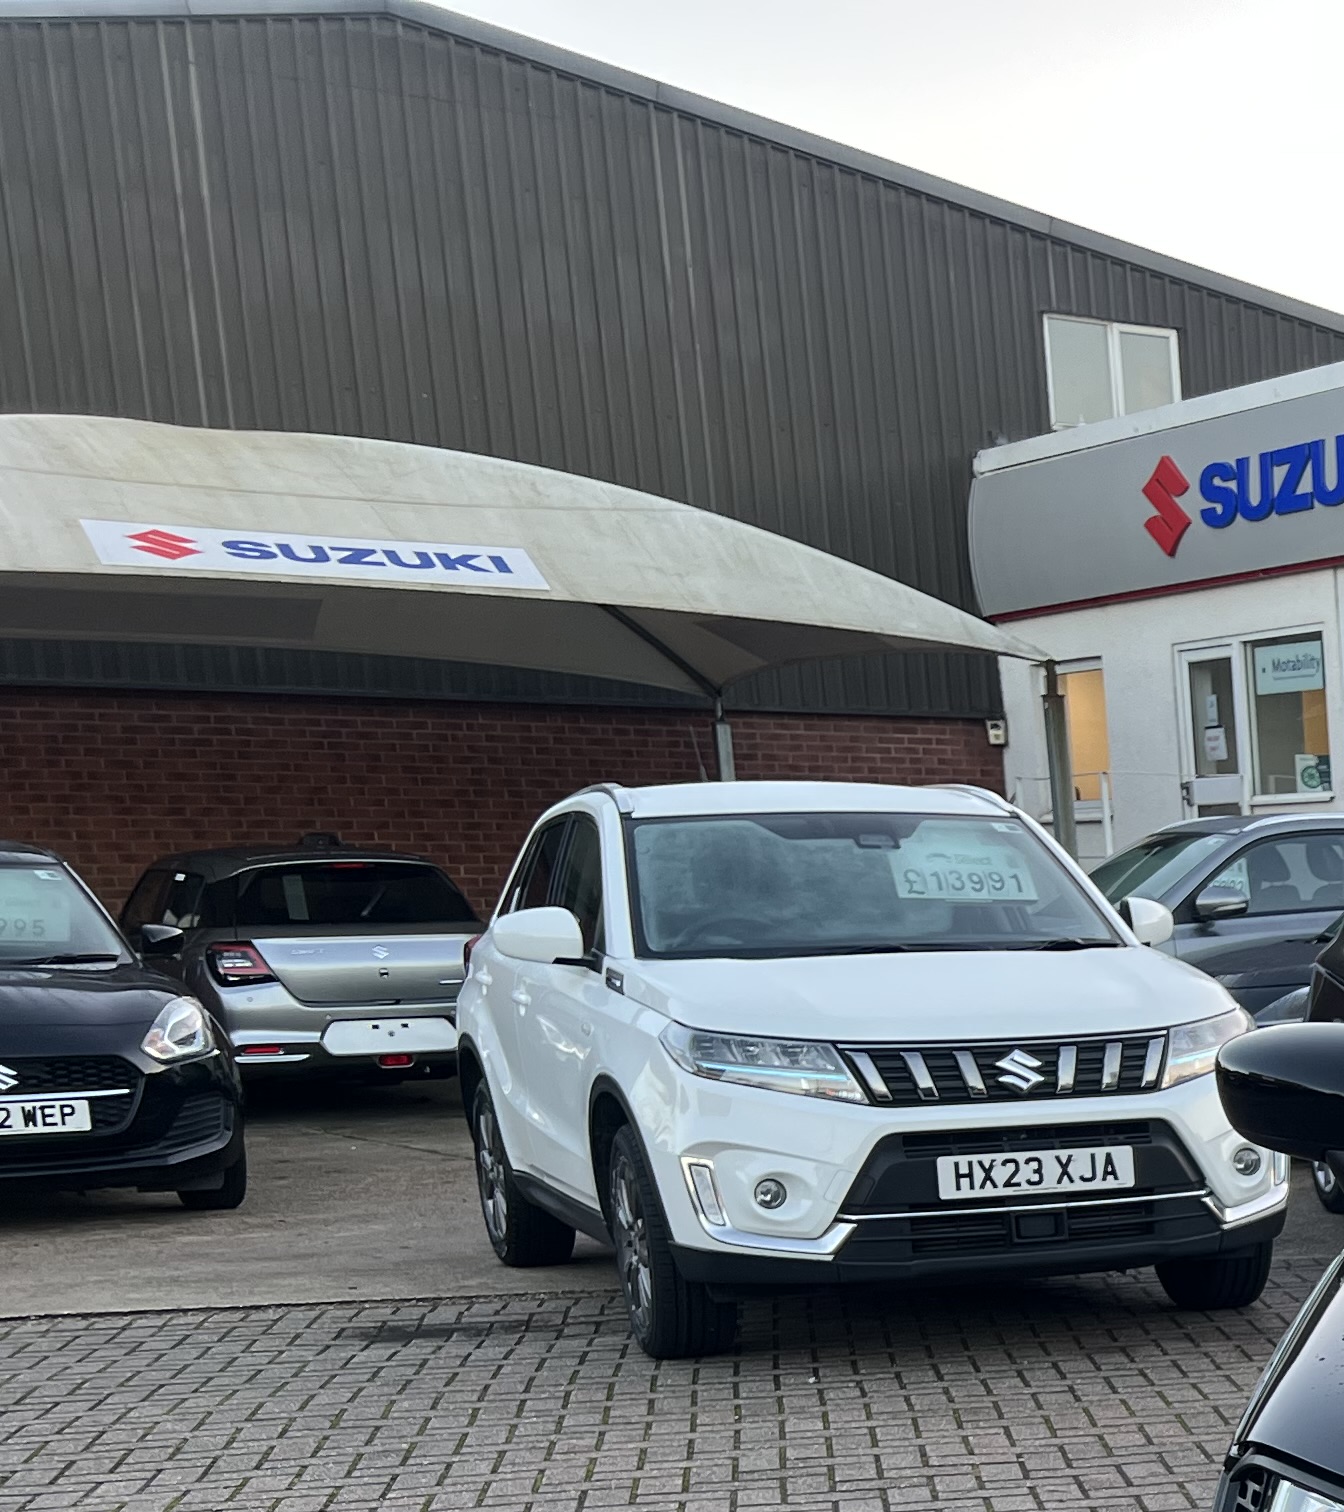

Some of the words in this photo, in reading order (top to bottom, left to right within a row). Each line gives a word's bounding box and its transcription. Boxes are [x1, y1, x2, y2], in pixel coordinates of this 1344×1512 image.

[220, 540, 514, 574] SUZUKI
[1271, 653, 1320, 673] Motability
[22, 1104, 76, 1128] WEP
[953, 1157, 1045, 1191] HX23
[1054, 1152, 1120, 1184] XJA
